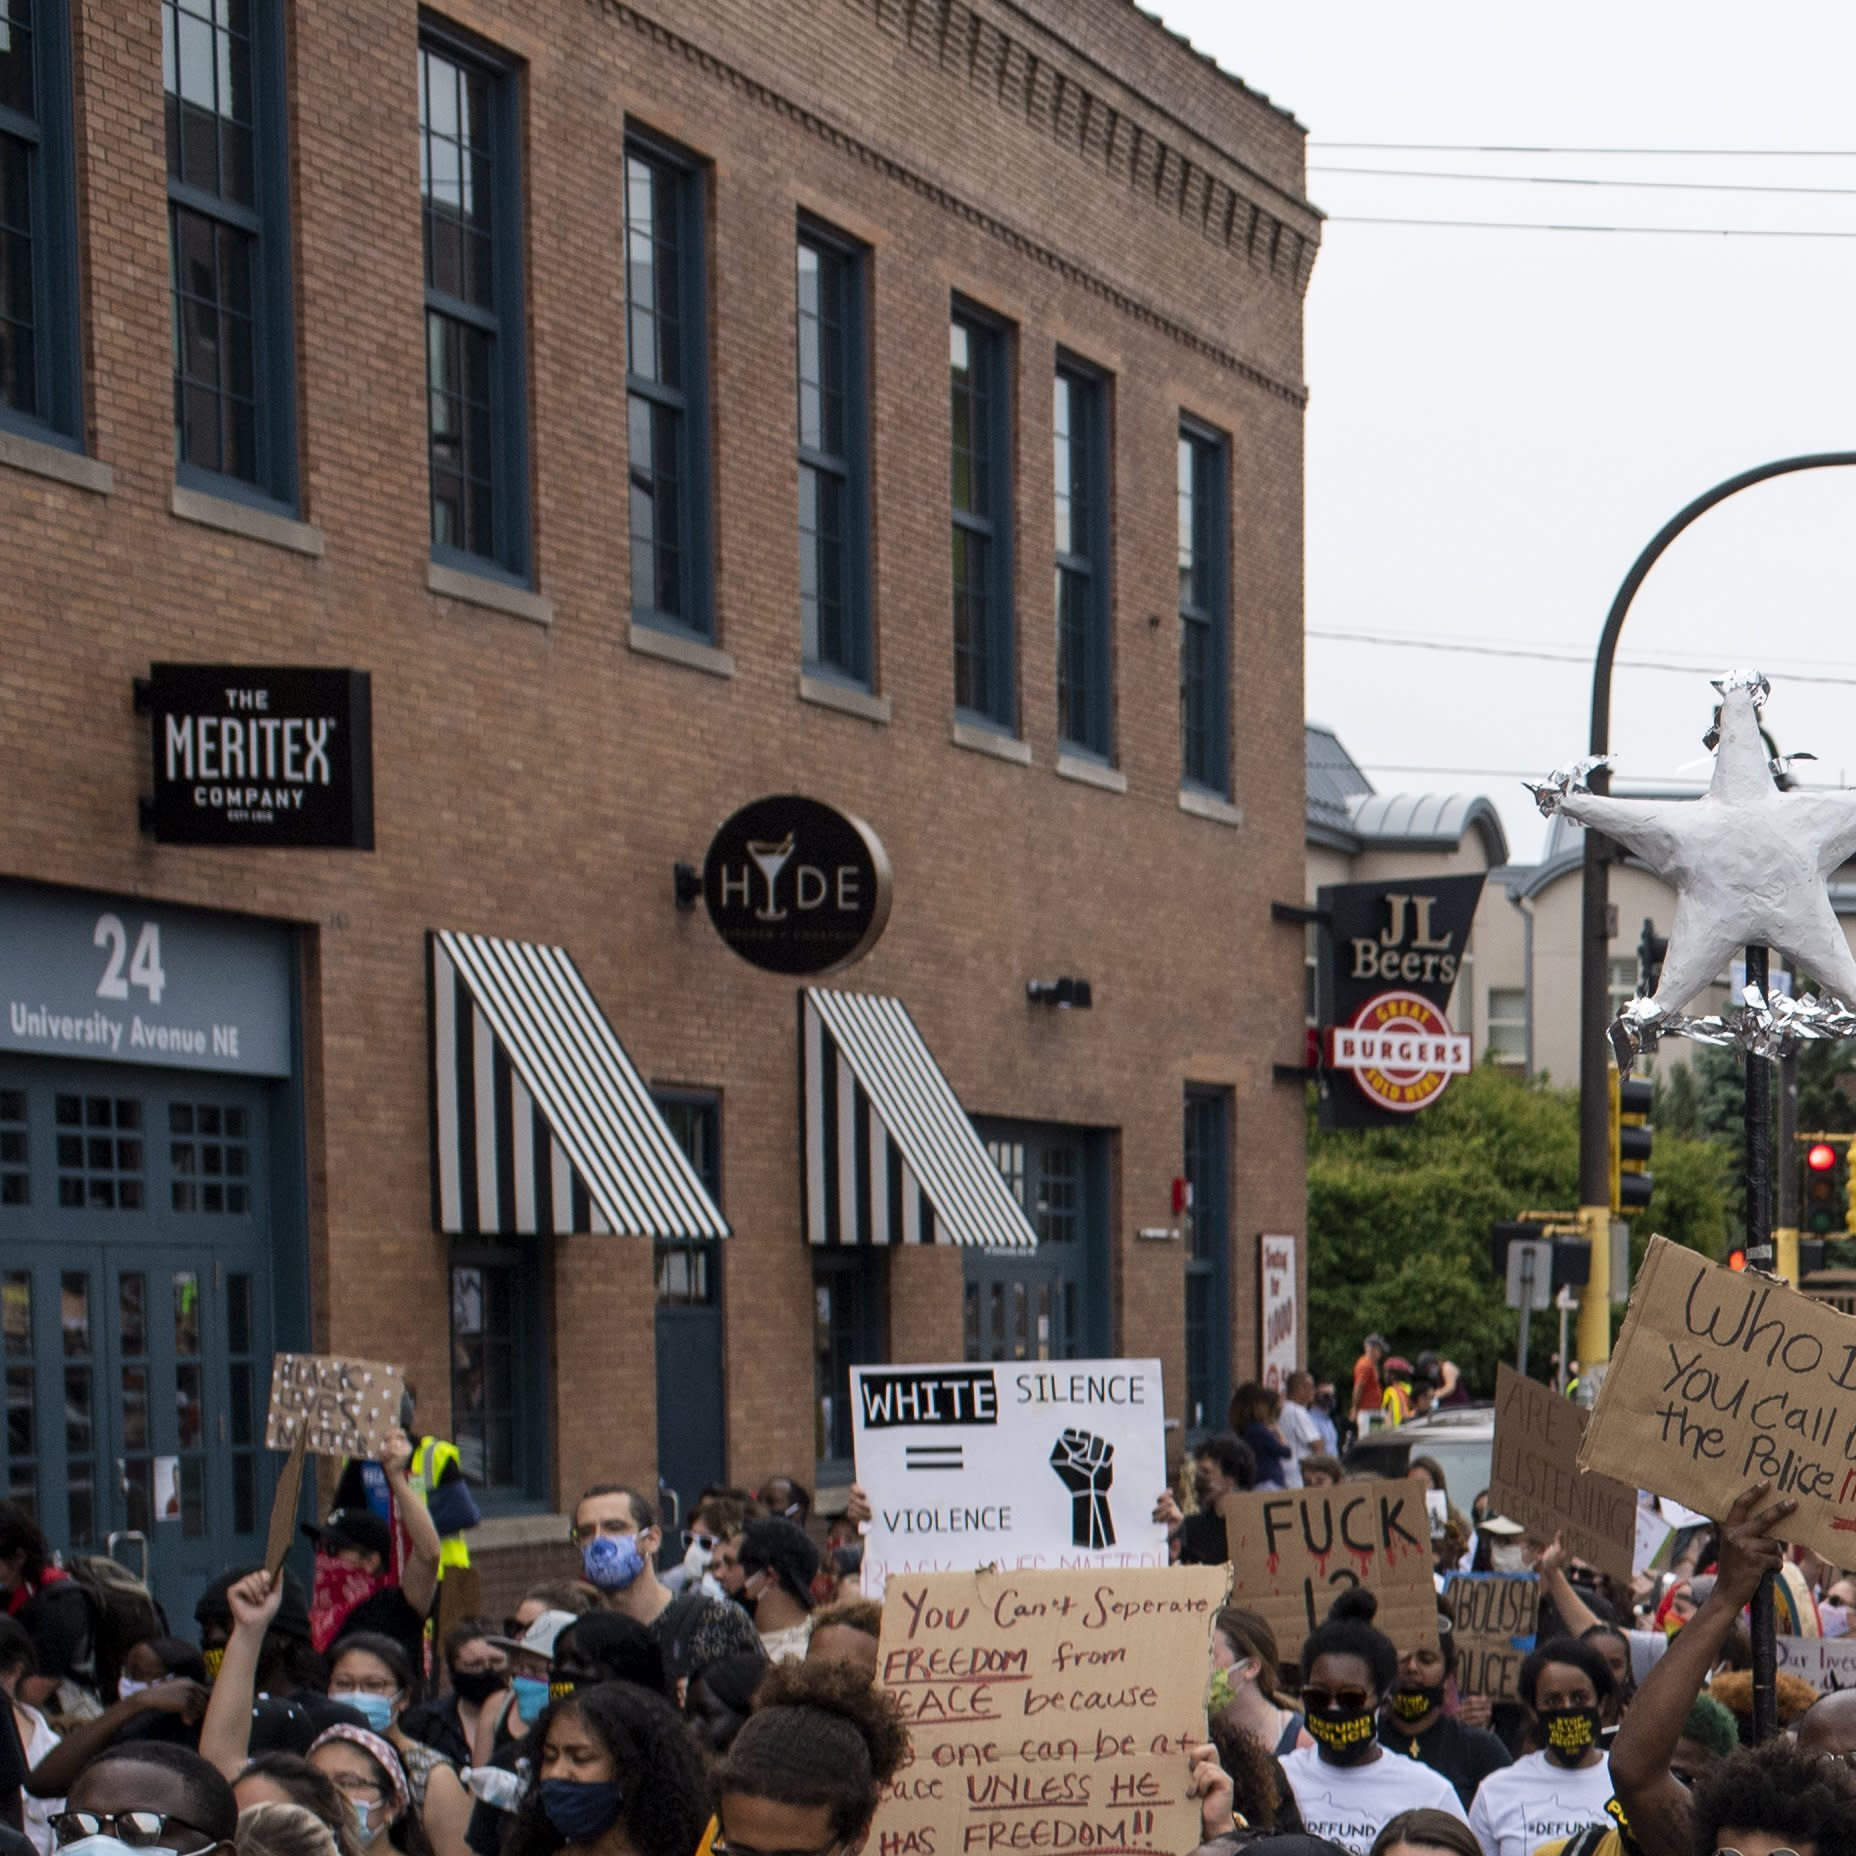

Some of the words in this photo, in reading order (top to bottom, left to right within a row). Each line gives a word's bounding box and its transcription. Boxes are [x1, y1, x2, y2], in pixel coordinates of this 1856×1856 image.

[226, 690, 268, 708] THE
[165, 714, 330, 785] MERITEX
[193, 786, 304, 809] COMPANY
[720, 836, 860, 921] HYDE
[1381, 893, 1452, 950] JL
[93, 914, 165, 1003] 24
[1351, 937, 1457, 985] Beers
[10, 1004, 122, 1053] University
[130, 1008, 206, 1053] Avenue
[212, 1022, 239, 1057] NE
[1343, 1038, 1463, 1063] BURGERS
[1683, 1265, 1824, 1374] Who
[862, 1379, 996, 1422] WHITE
[1016, 1375, 1145, 1405] SILENCE
[1661, 1343, 1749, 1420] You
[1656, 1399, 1727, 1463] the
[1742, 1435, 1836, 1500] Police
[883, 1506, 1013, 1534] VIOLENCE
[1263, 1497, 1419, 1554] FUCK
[903, 1588, 970, 1638] You
[1082, 1585, 1210, 1629] Seperate
[883, 1648, 1028, 1680] FREEDOM
[1051, 1642, 1128, 1667] from
[1024, 1683, 1159, 1710] because
[1308, 1714, 1372, 1734] DEFUND
[932, 1739, 999, 1770] one
[1018, 1737, 1079, 1761] can
[1093, 1730, 1138, 1760] be
[1149, 1731, 1196, 1756] at
[966, 1773, 1091, 1802] UNLESS
[1110, 1774, 1161, 1798] HE
